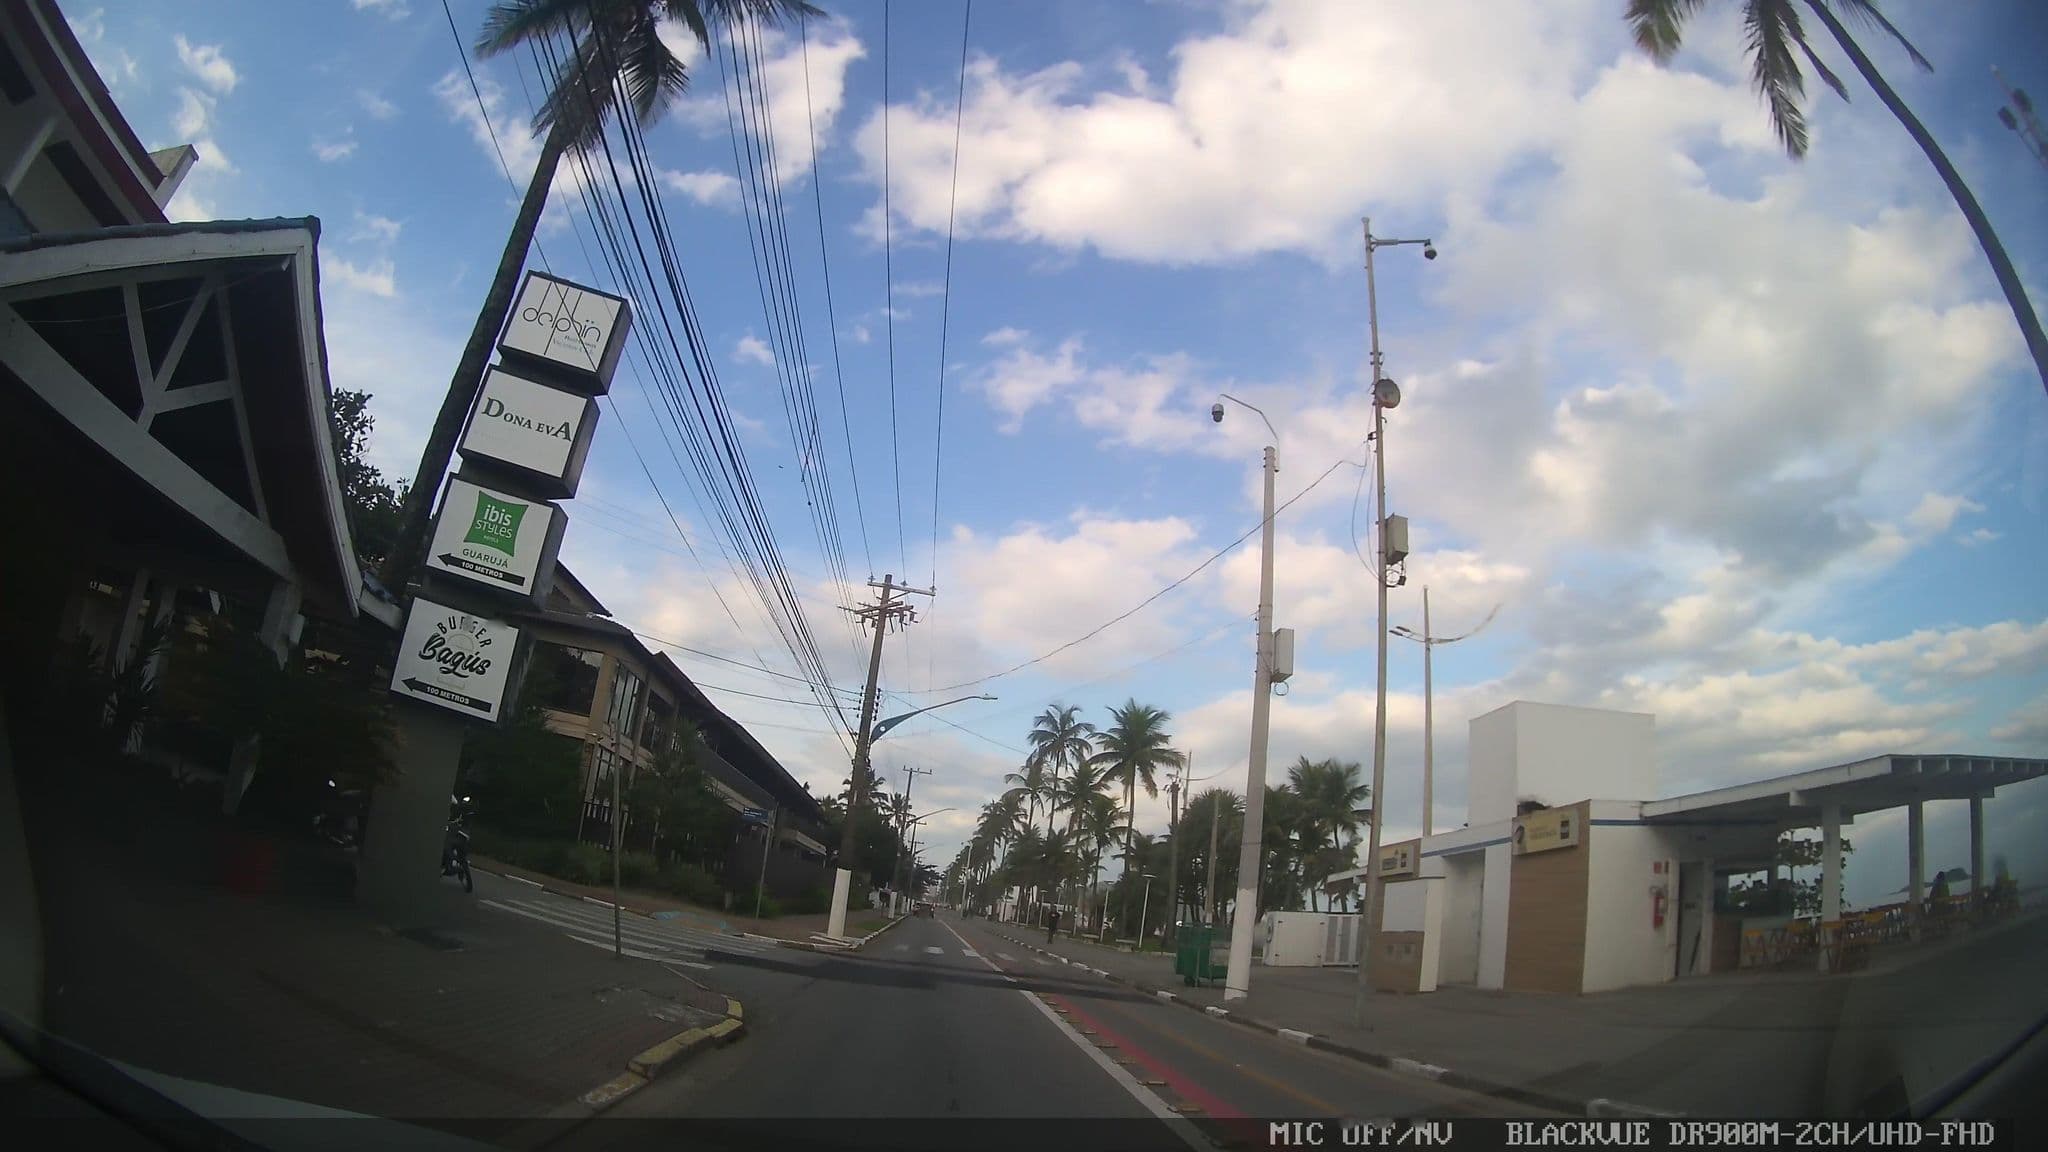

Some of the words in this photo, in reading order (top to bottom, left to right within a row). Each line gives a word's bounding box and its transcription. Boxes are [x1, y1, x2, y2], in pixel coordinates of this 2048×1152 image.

[484, 504, 513, 526] ibis
[462, 548, 509, 569] GUARUJÁ
[461, 561, 474, 570] 100
[474, 565, 504, 579] METROS
[426, 686, 440, 696] 100
[439, 690, 470, 705] METROS
